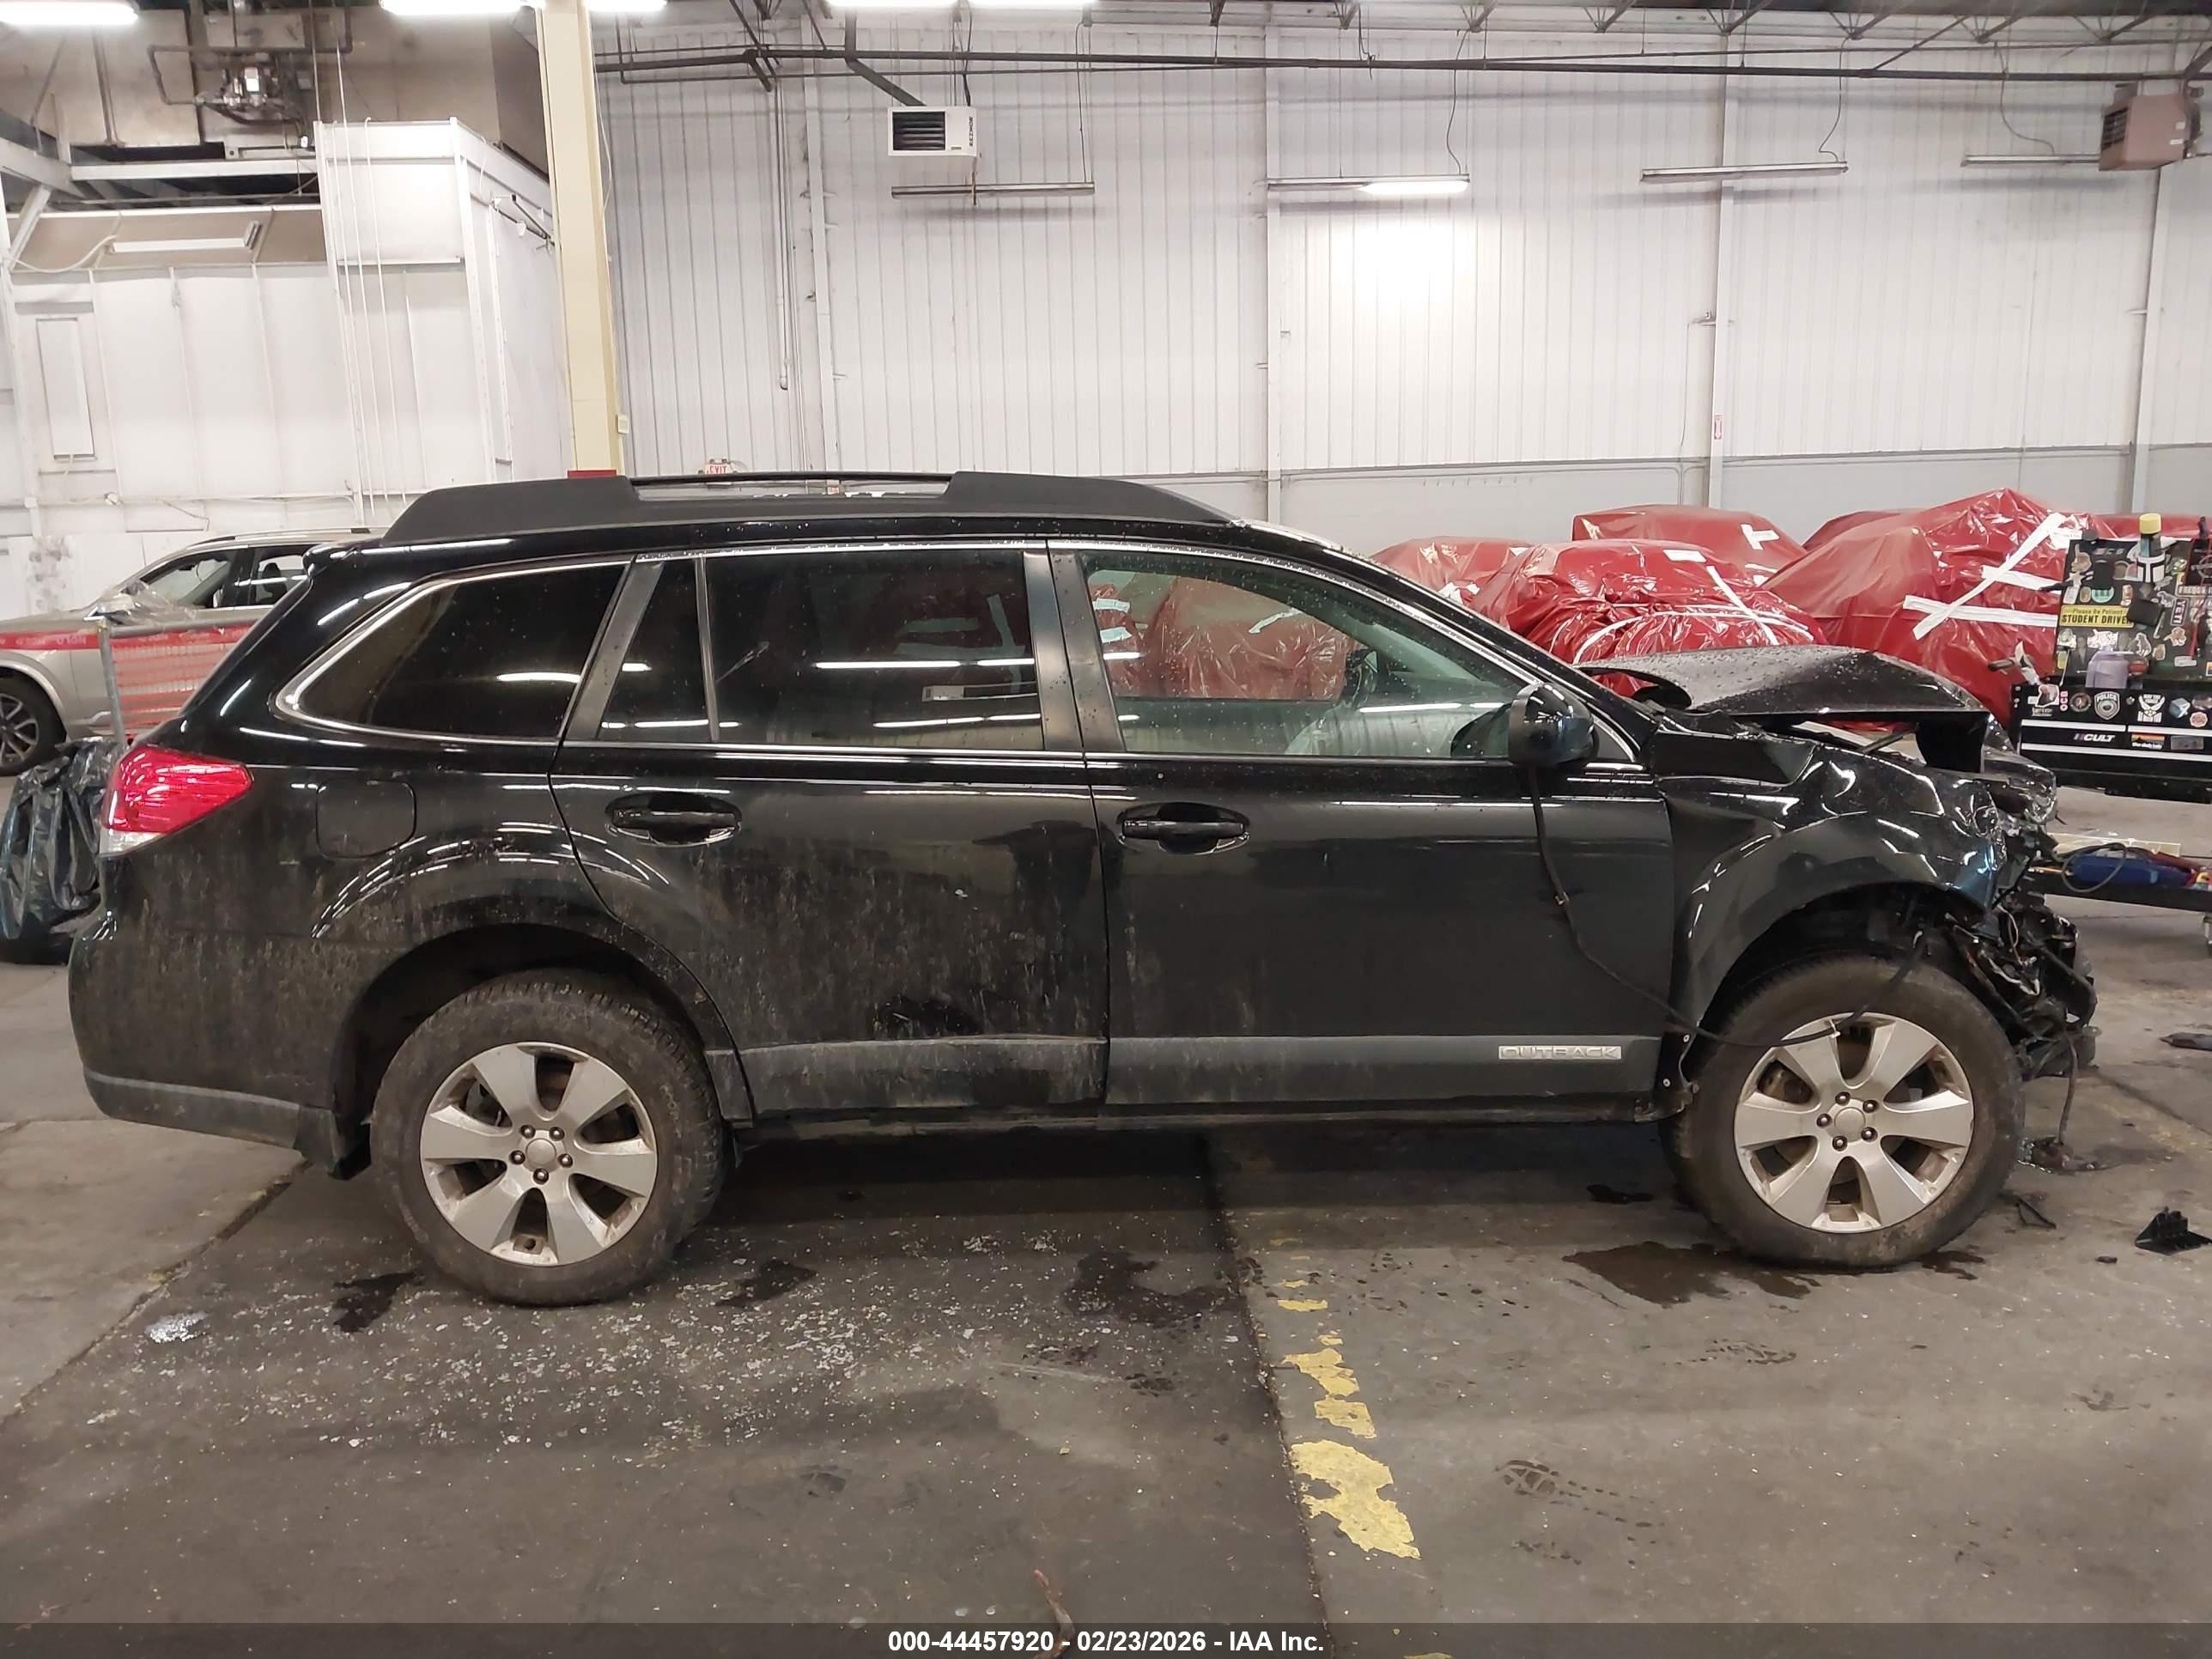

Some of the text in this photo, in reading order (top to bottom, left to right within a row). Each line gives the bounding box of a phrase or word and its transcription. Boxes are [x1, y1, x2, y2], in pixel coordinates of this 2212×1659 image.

[2173, 599, 2186, 623] YETI
[2062, 614, 2099, 623] STUDENT
[2096, 693, 2117, 702] POLICE
[1501, 1046, 1619, 1059] OUTBACK
